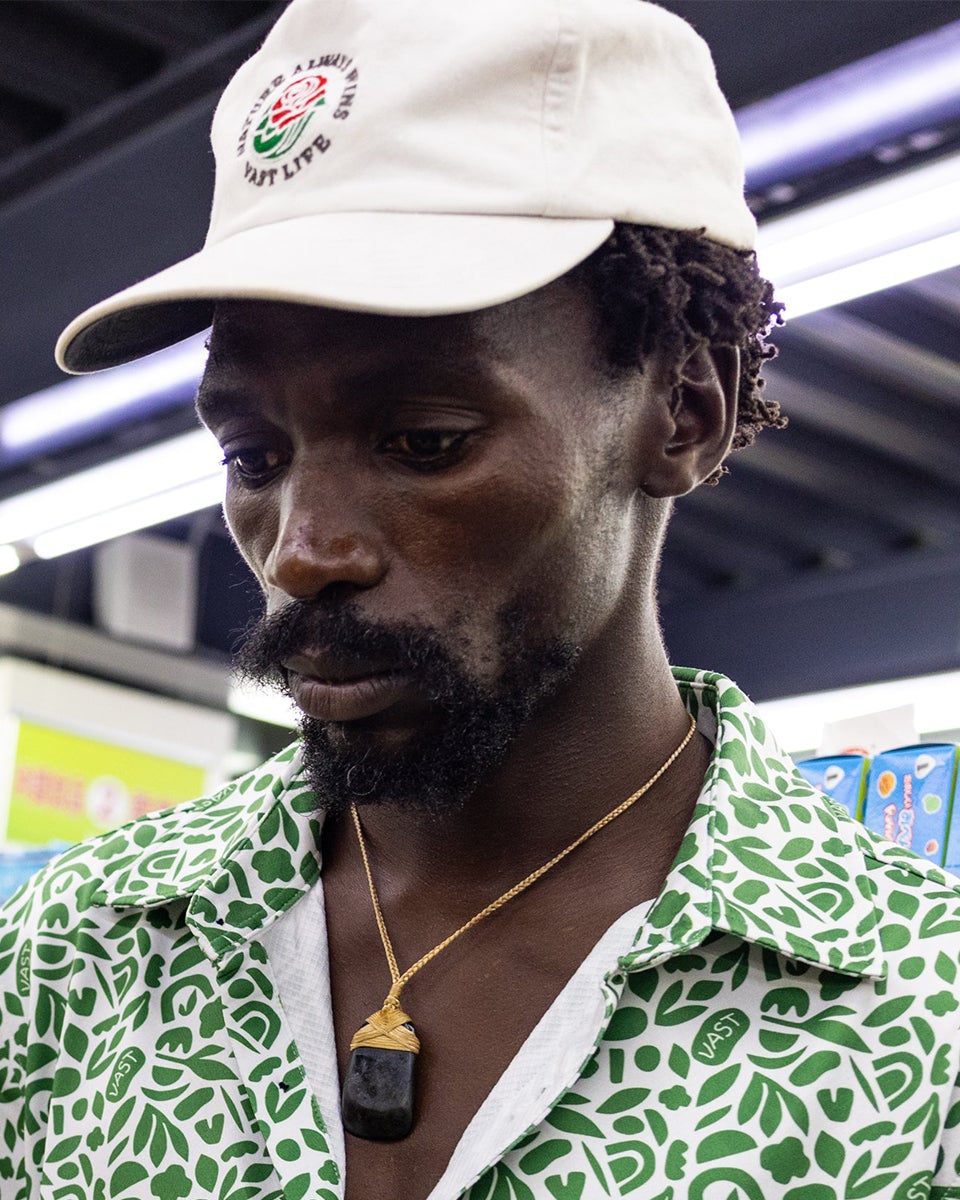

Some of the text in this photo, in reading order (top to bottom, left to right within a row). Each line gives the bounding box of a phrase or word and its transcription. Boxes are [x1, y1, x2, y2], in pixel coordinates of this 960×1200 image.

[333, 67, 359, 120] WINS
[244, 133, 332, 187] VAST LIFE
[21, 944, 31, 992] VAST
[698, 1012, 742, 1060] VAST
[108, 1049, 140, 1098] VAST
